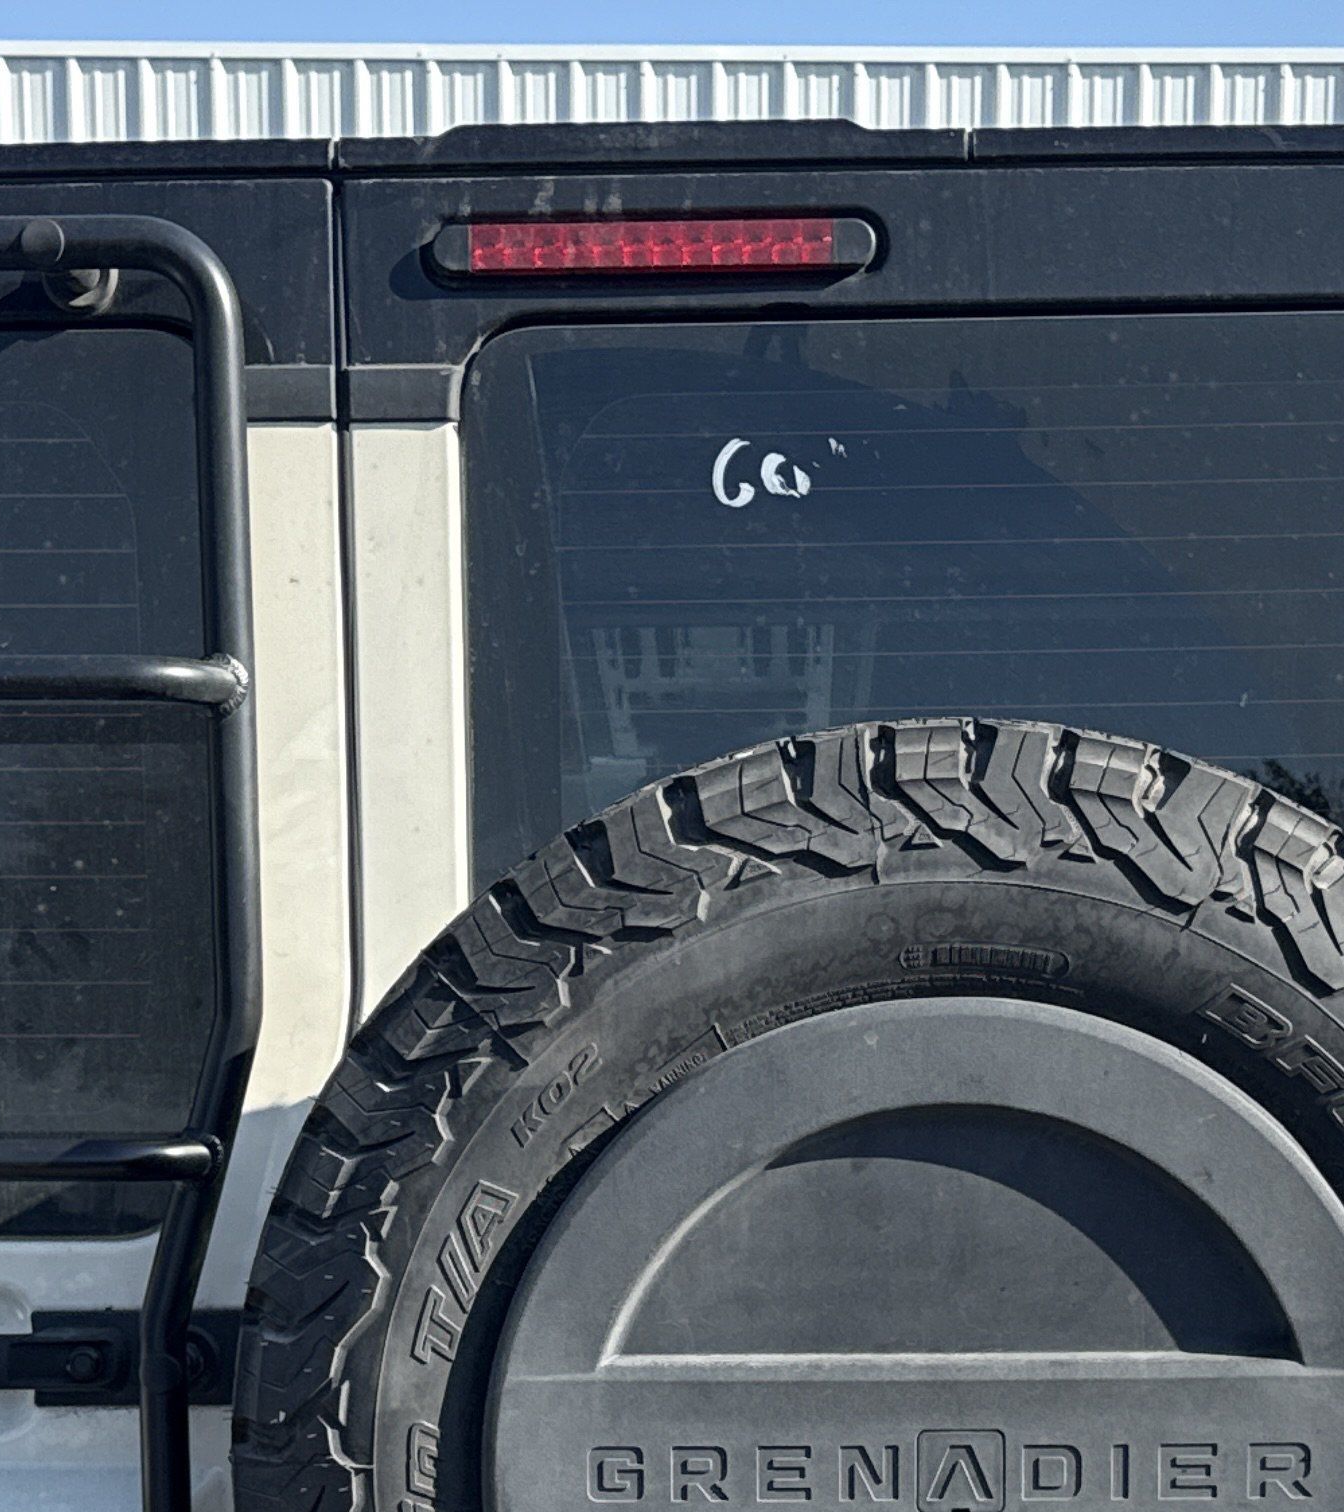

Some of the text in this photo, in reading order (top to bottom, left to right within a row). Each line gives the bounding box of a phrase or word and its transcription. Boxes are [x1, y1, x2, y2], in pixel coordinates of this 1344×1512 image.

[410, 1179, 519, 1365] T/A
[510, 1042, 603, 1148] KO2
[587, 1443, 1313, 1502] GRENADIER
